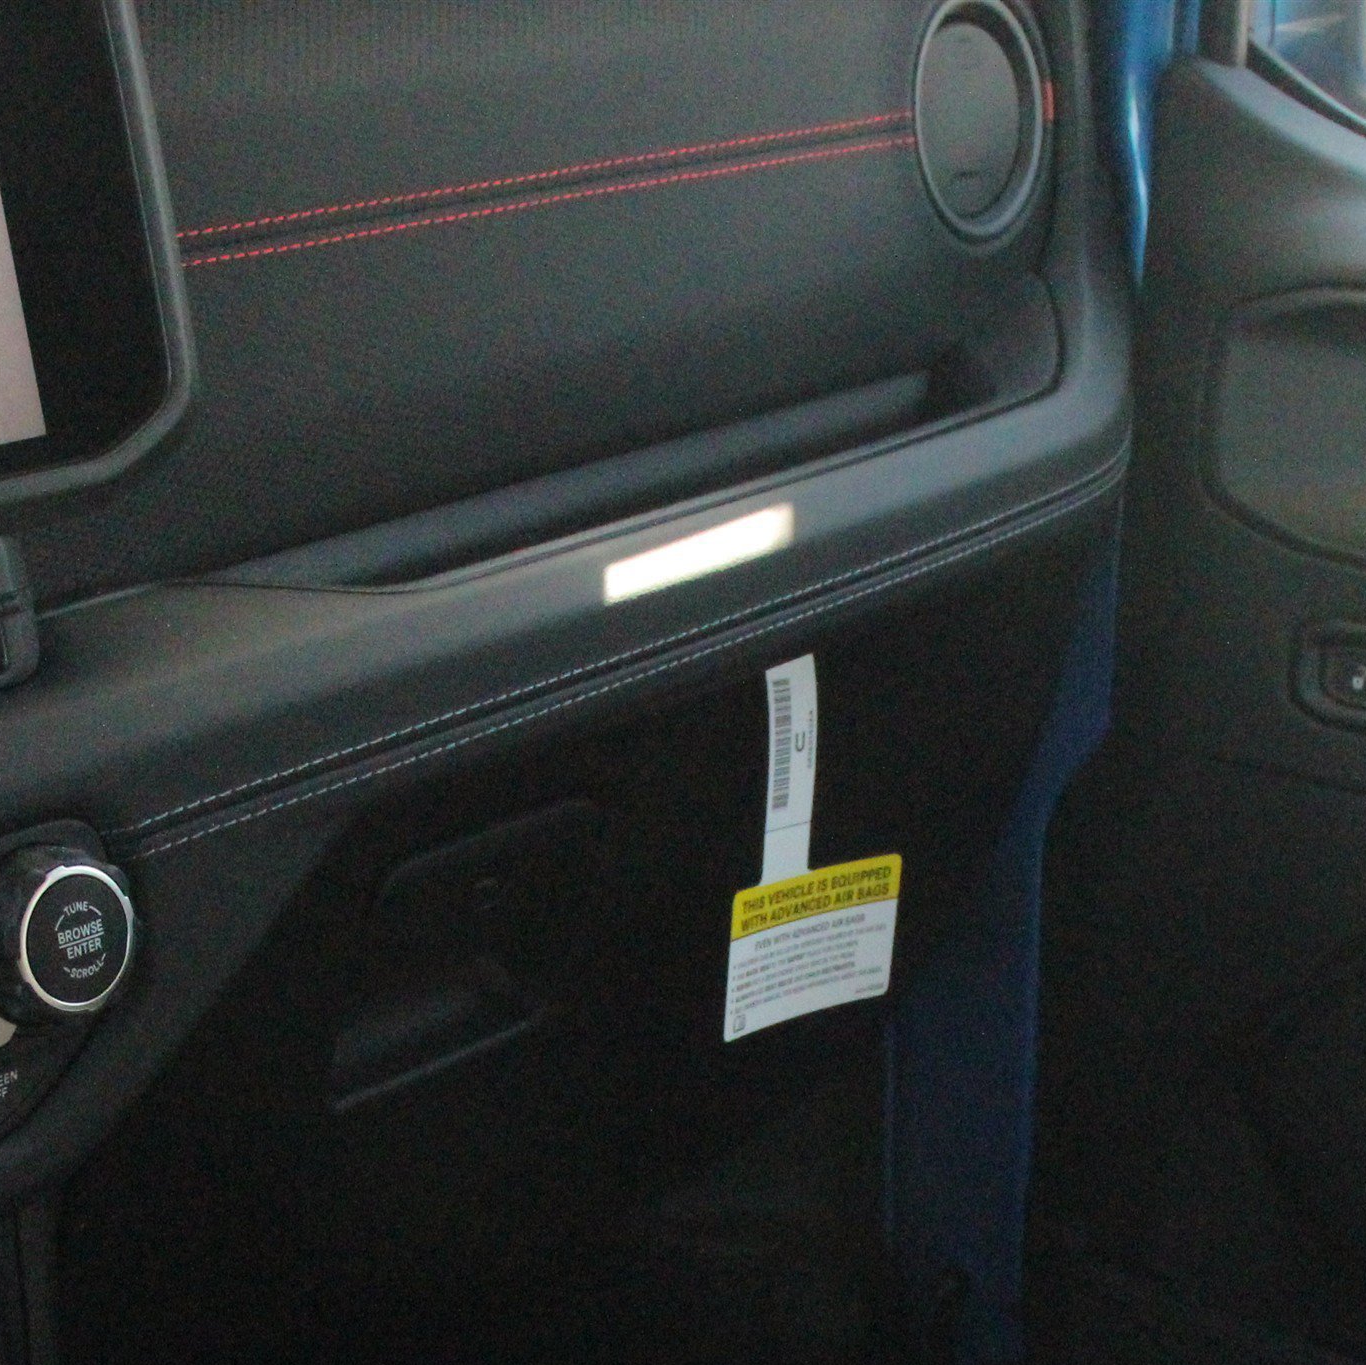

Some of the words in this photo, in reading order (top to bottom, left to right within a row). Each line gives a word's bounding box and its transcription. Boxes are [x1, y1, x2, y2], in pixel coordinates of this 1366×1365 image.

[742, 895, 766, 914] THIS
[768, 881, 815, 906] VEHICLE
[817, 878, 828, 893] IS
[831, 865, 892, 890] EQUIPPED
[63, 901, 89, 916] TUNE
[741, 912, 768, 932] WITH
[770, 894, 831, 921] ADVANCED
[835, 889, 855, 904] AIR
[857, 883, 890, 899] BAGS
[58, 918, 104, 945] BROWSE
[67, 937, 103, 960] ENTER
[70, 959, 105, 979] SCROLL
